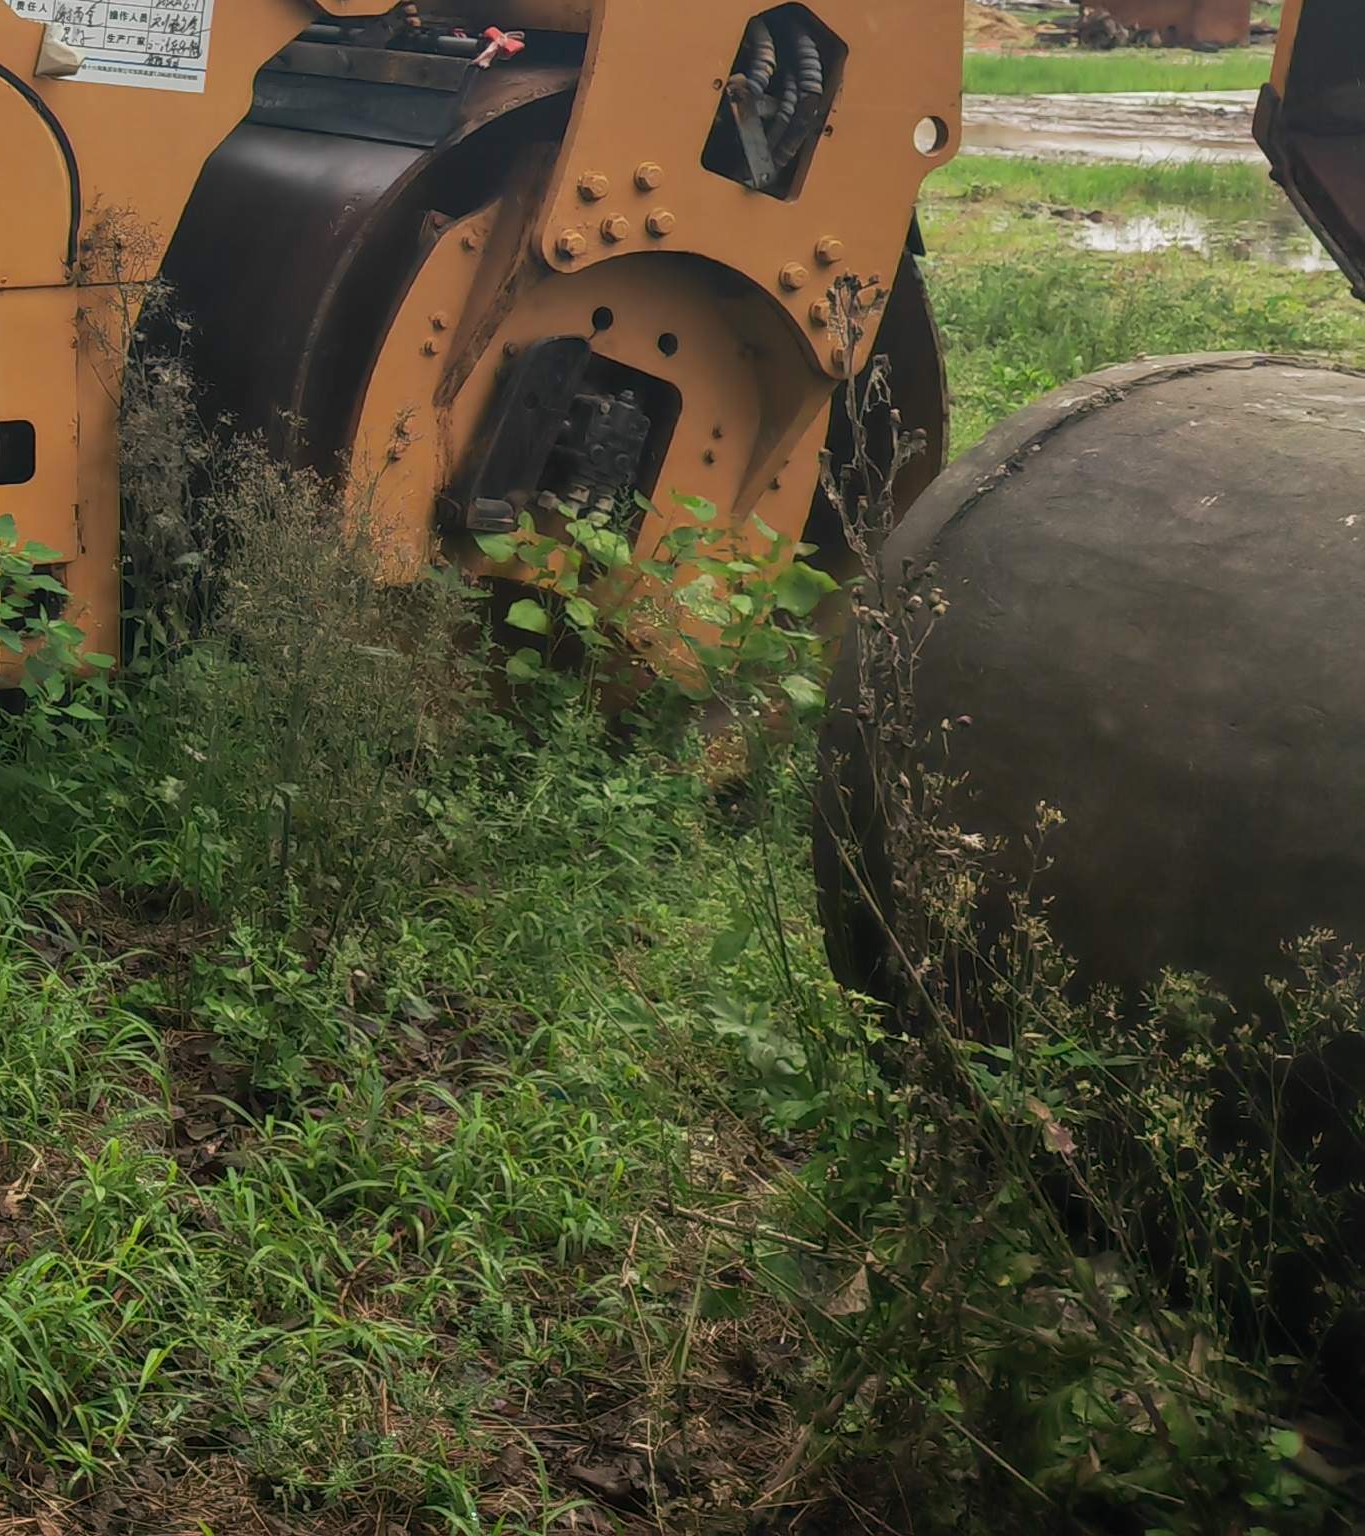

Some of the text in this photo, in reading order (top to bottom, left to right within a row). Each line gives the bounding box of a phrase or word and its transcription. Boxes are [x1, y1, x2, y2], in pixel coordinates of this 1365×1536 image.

[16, 0, 49, 14] 责任人
[109, 8, 148, 24] 操作人员
[107, 34, 146, 47] 生产厂家
